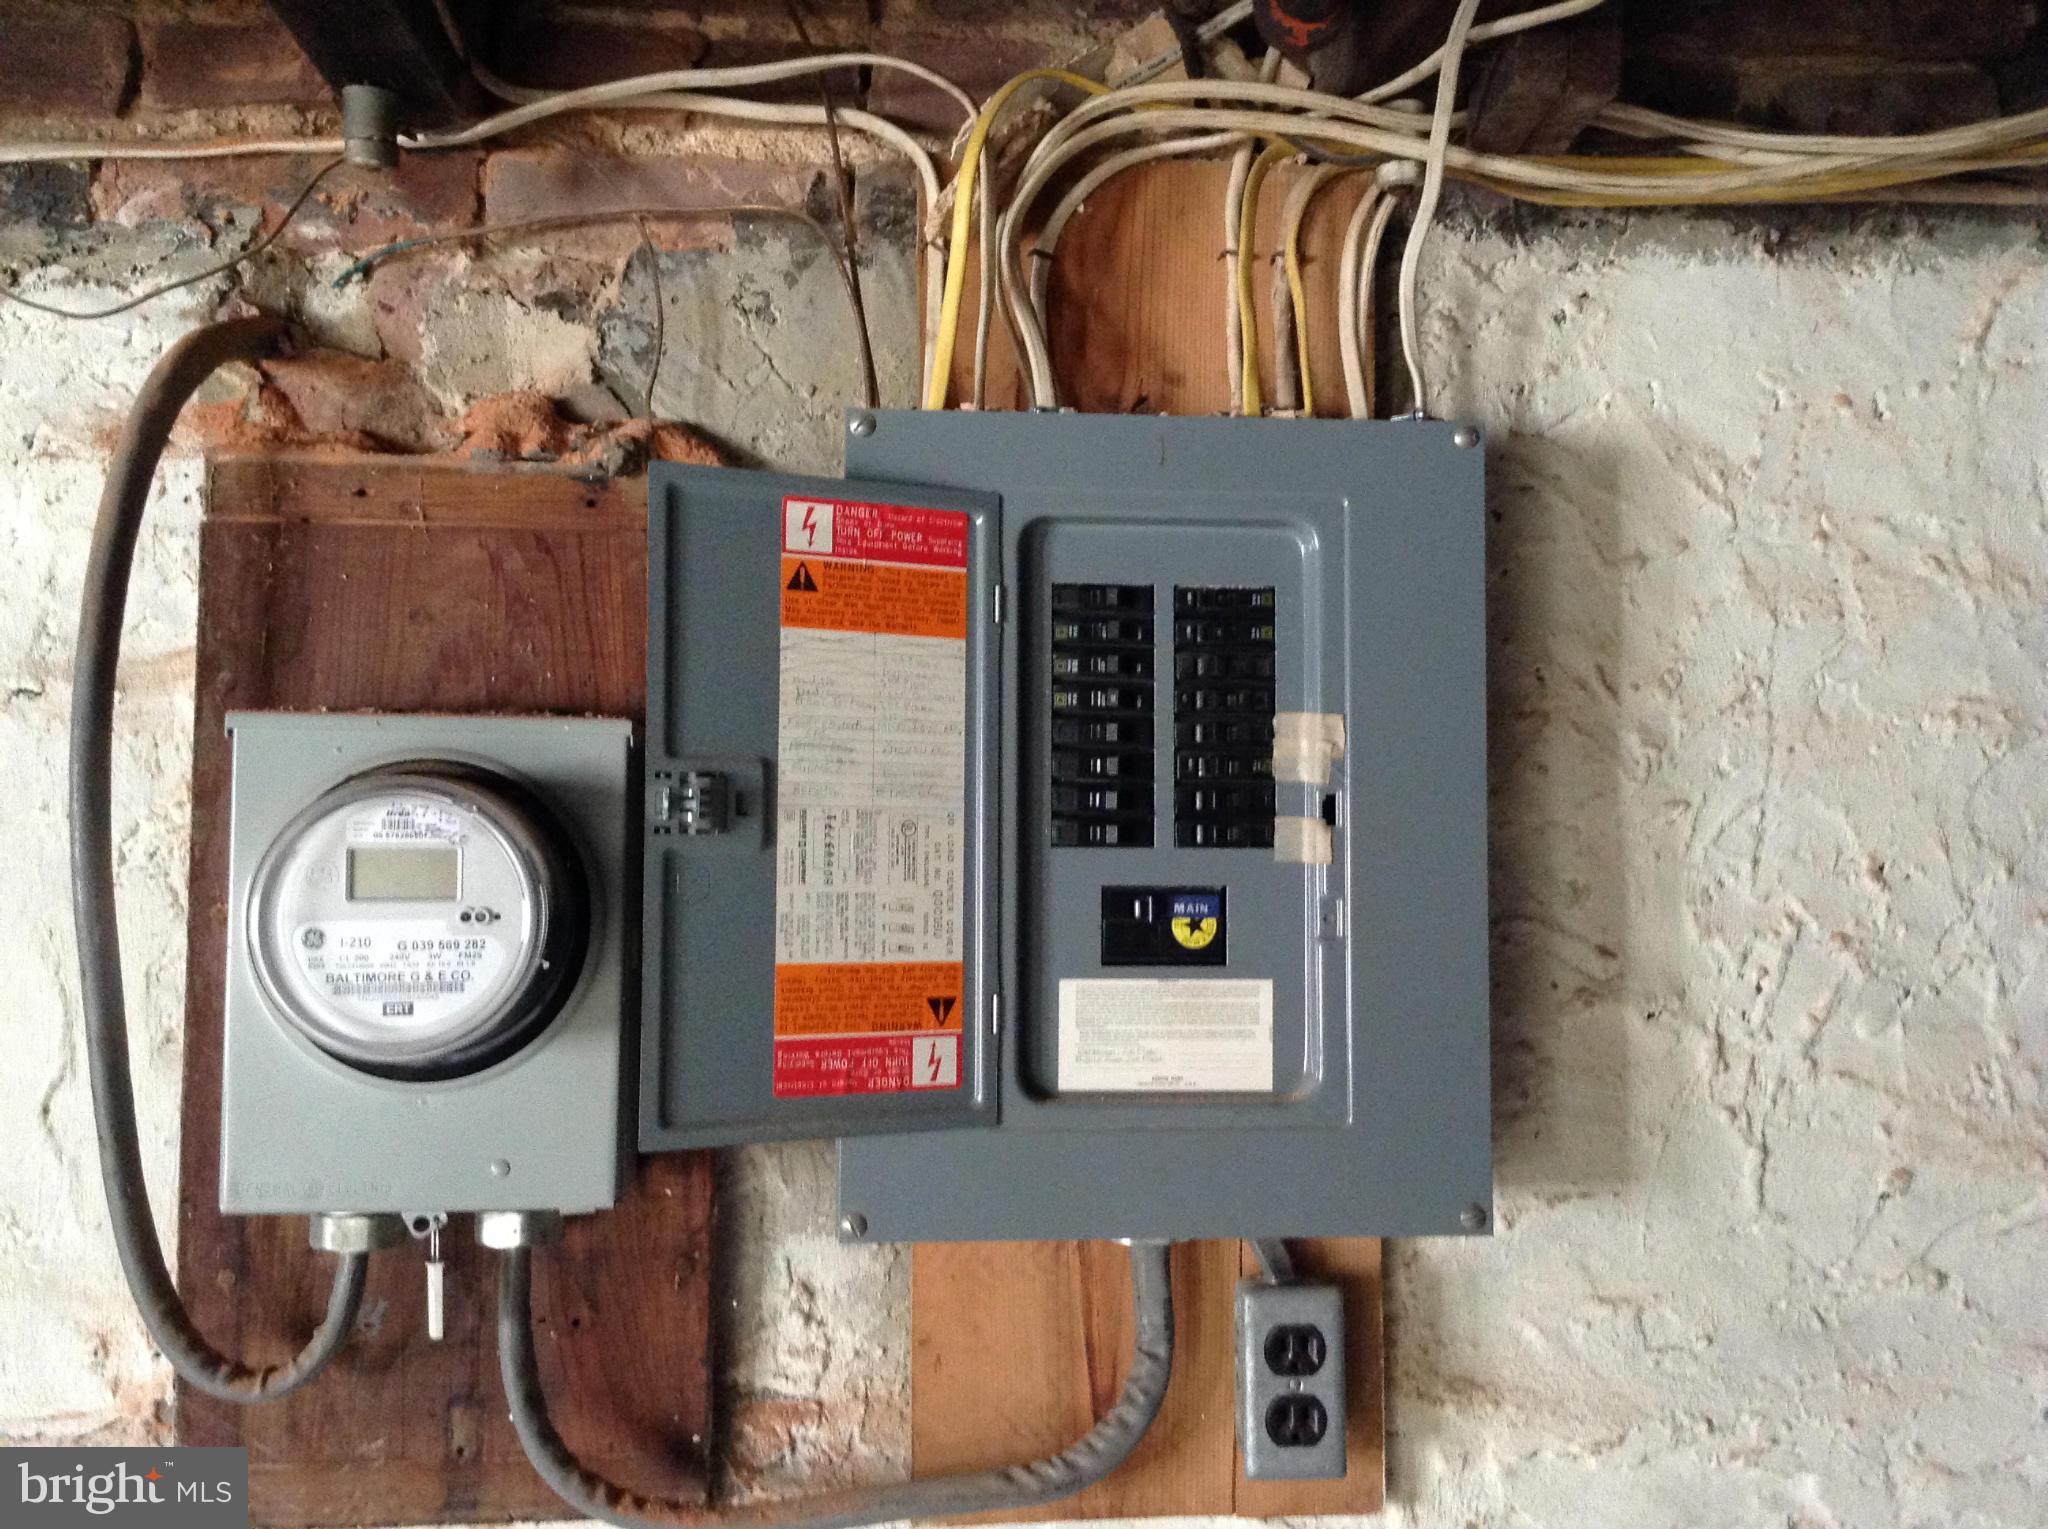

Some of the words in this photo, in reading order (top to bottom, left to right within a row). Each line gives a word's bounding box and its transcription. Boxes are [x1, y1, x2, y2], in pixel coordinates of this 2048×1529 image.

[836, 504, 878, 519] DANGER
[837, 526, 860, 537] TURN
[891, 529, 923, 543] POWER
[1173, 902, 1209, 915] MAIN
[397, 940, 408, 951] G
[326, 971, 405, 984] BALTIMORE
[410, 971, 420, 982] G
[425, 970, 434, 982] &
[438, 970, 446, 981] E
[821, 1057, 854, 1071] POWER
[885, 1055, 909, 1068] TURN
[868, 1075, 910, 1090] DANGER
